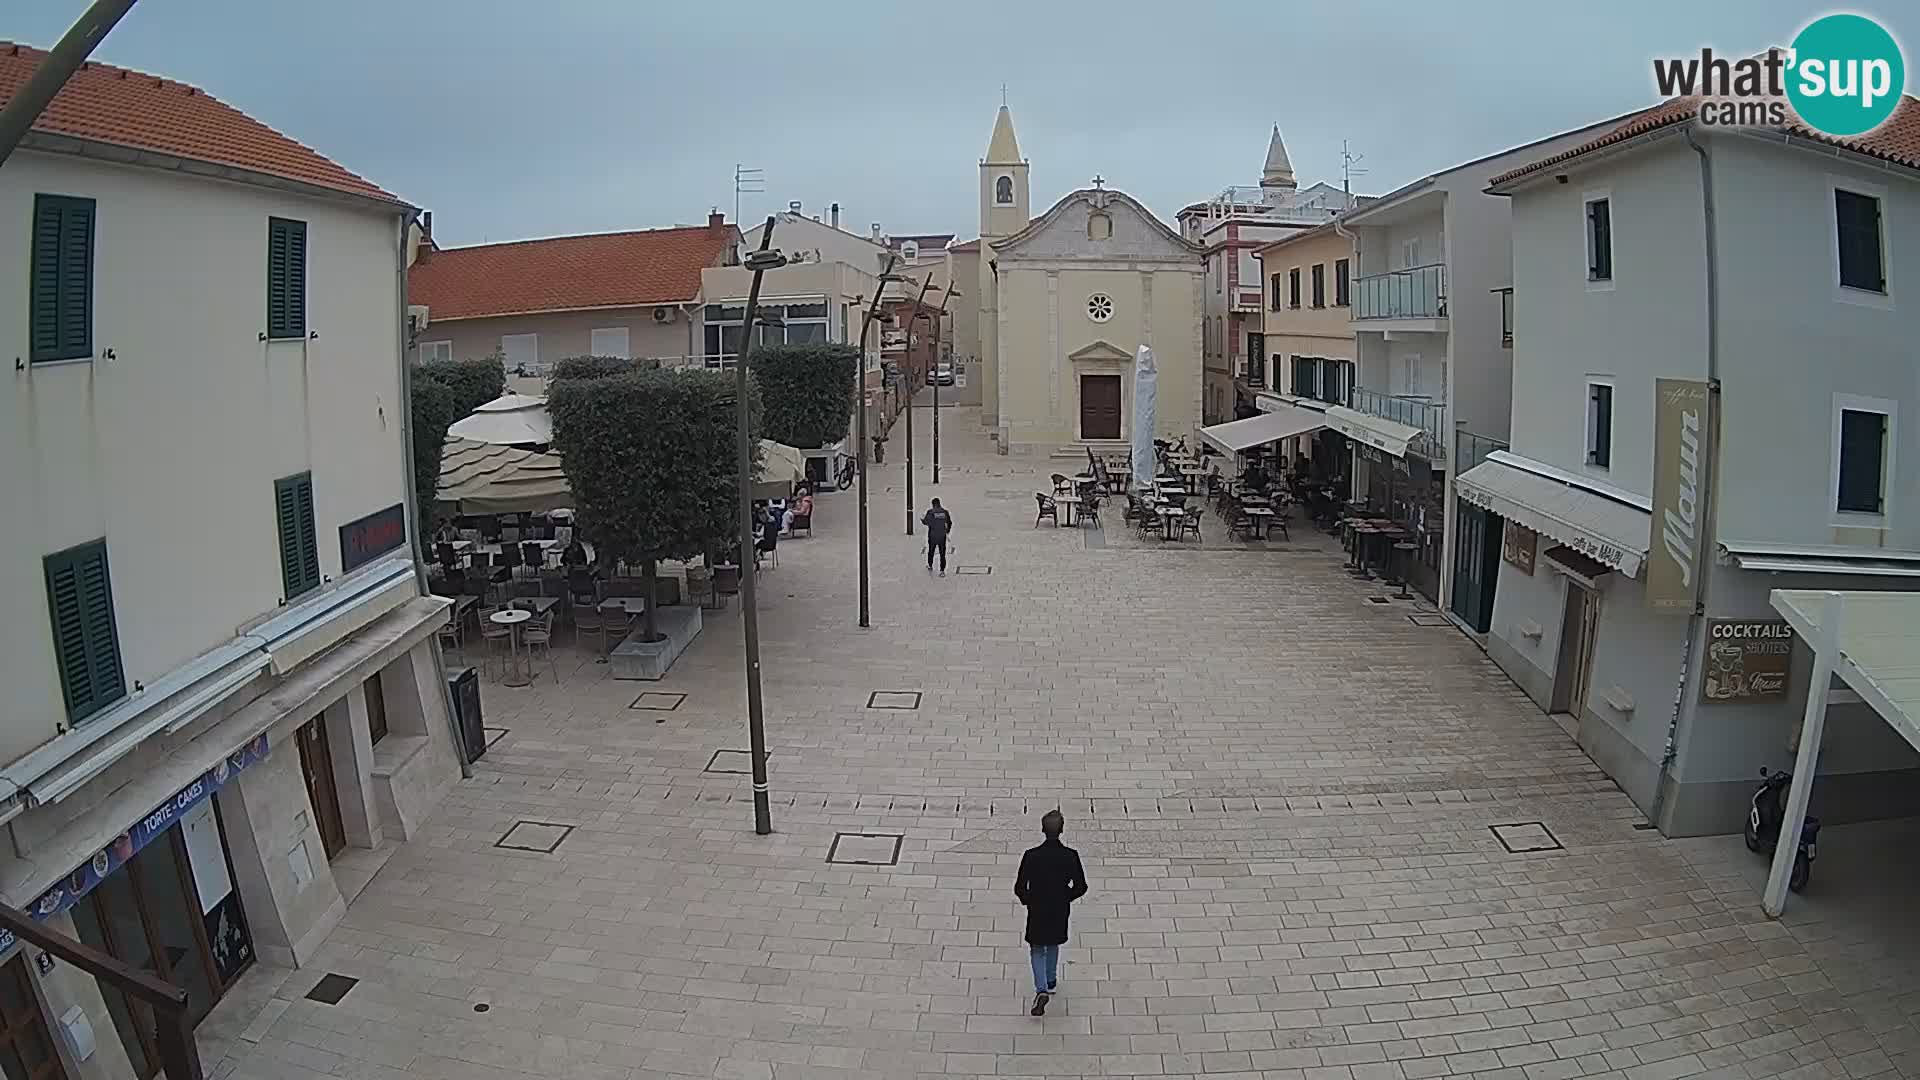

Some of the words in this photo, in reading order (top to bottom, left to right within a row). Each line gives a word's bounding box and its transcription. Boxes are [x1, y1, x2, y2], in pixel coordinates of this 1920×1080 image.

[1712, 624, 1792, 638] COCKTAILS
[143, 803, 173, 834] TORTE
[177, 780, 203, 809] CAKES
